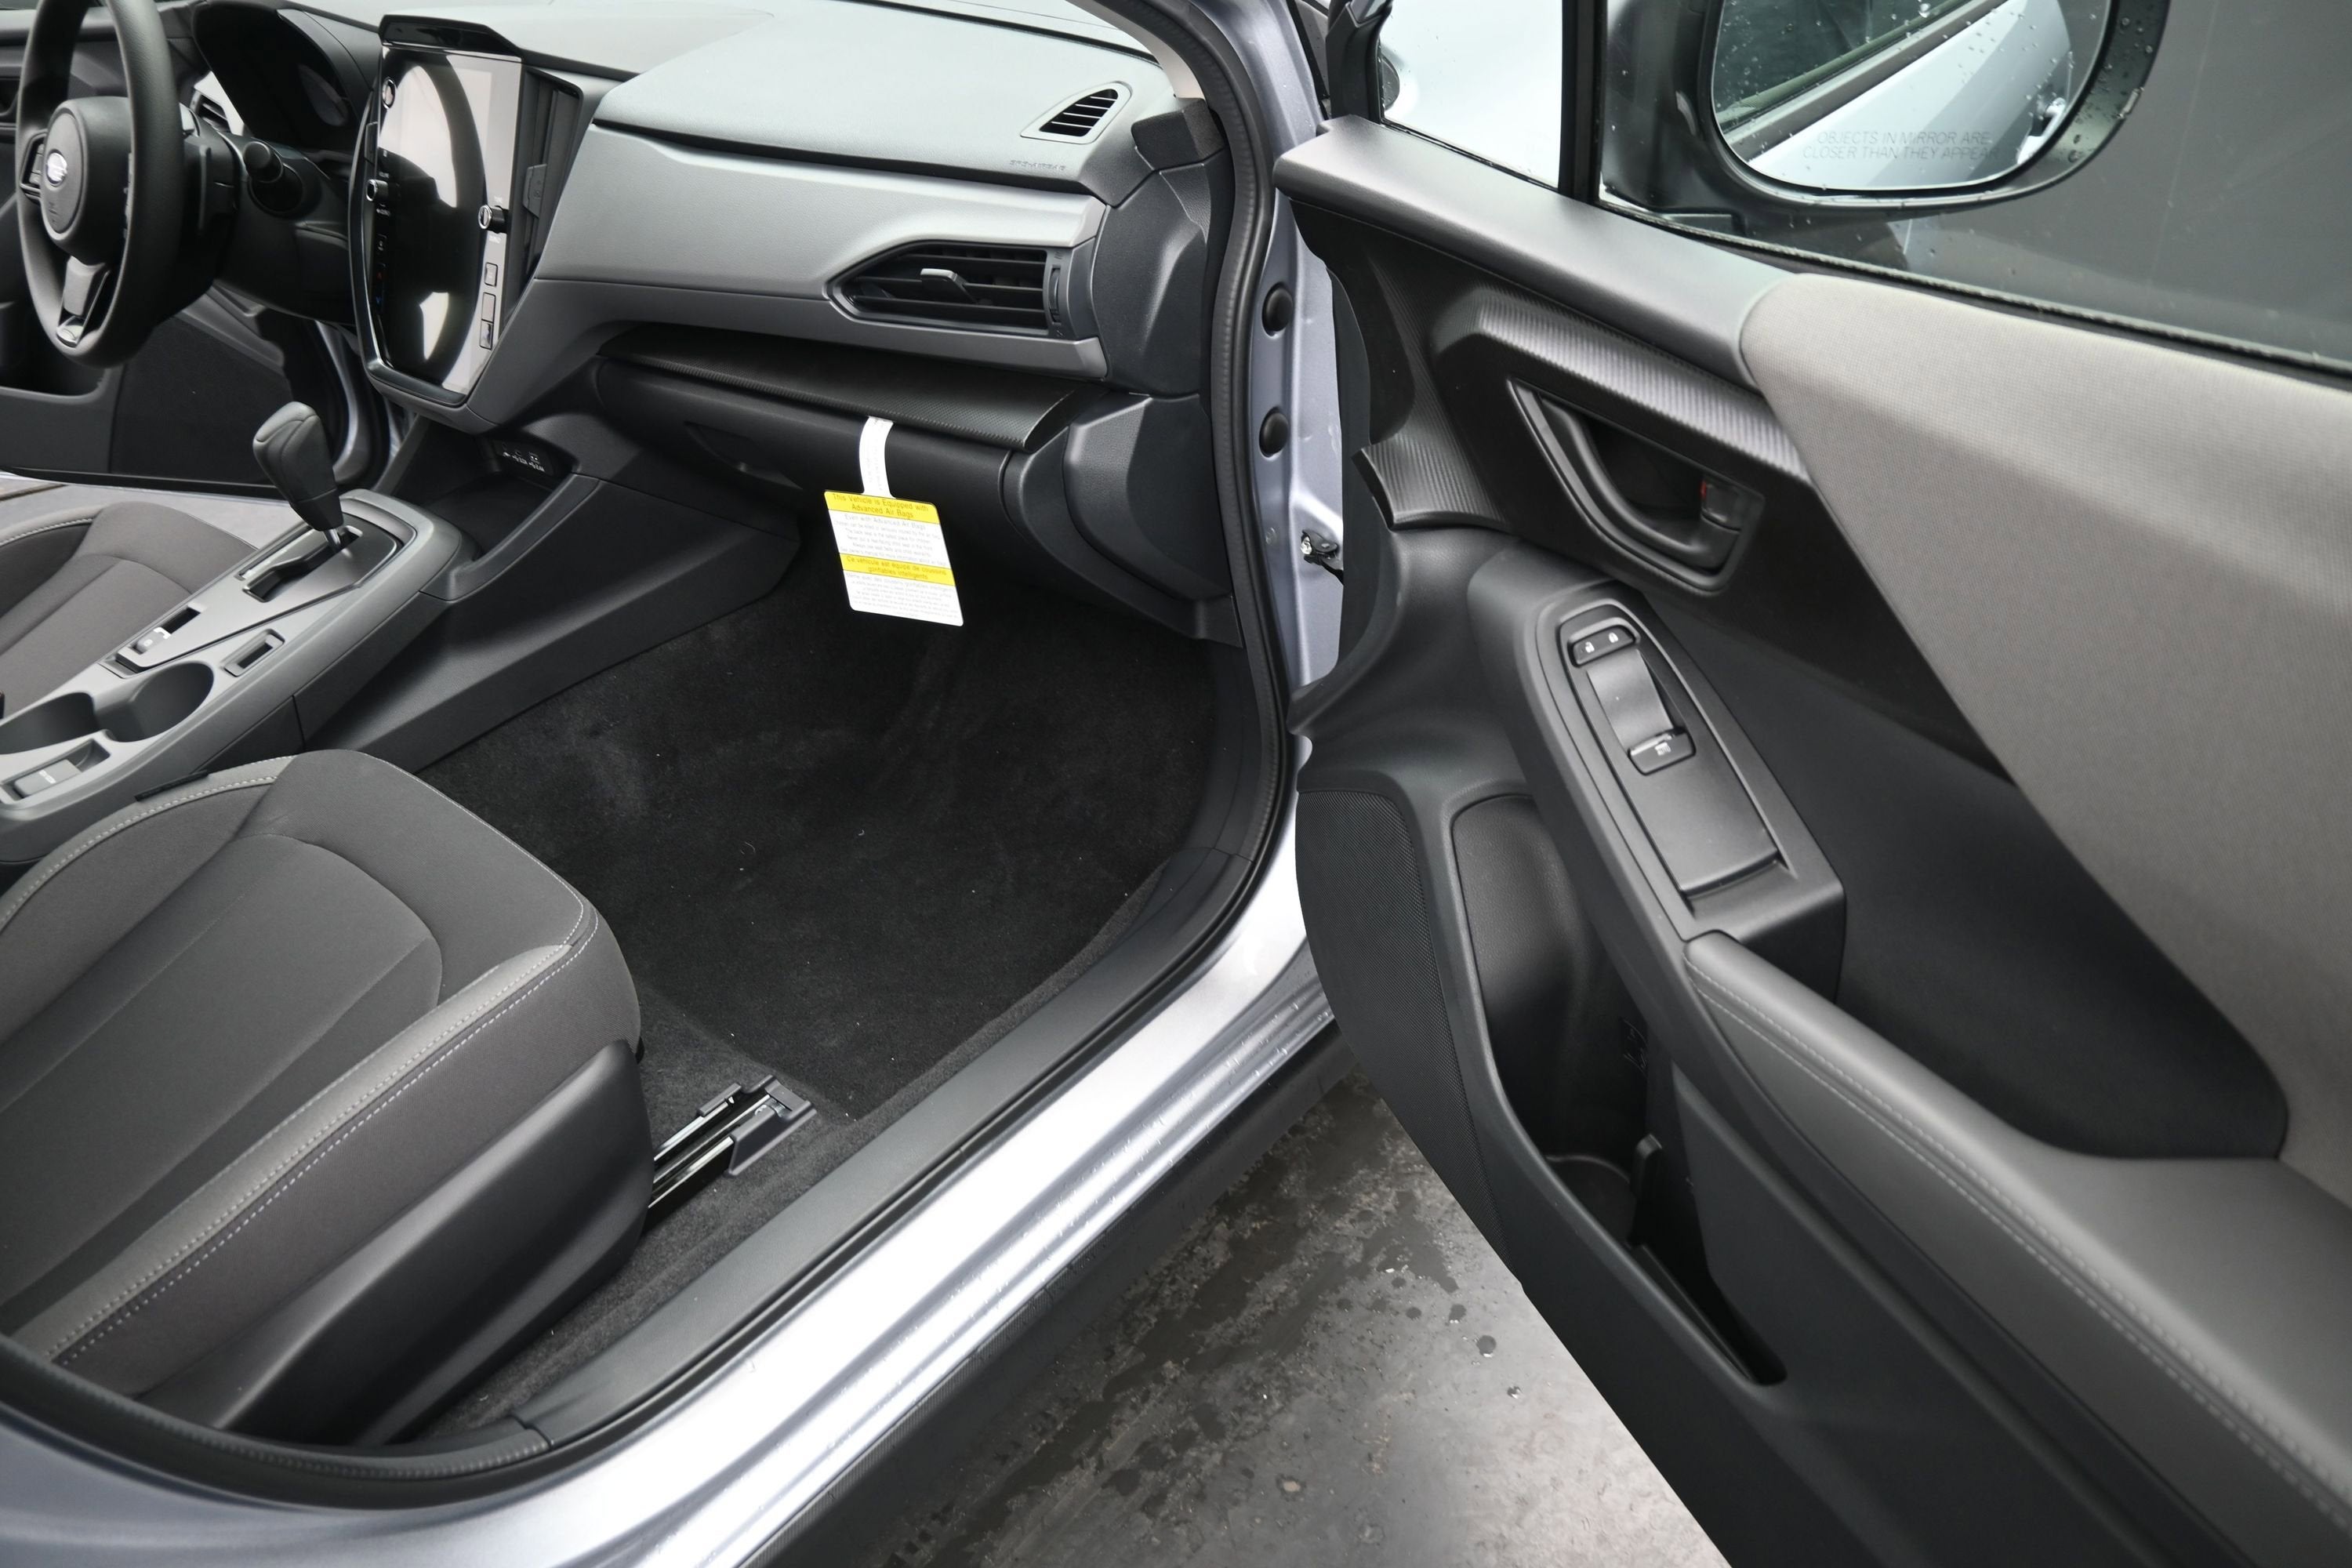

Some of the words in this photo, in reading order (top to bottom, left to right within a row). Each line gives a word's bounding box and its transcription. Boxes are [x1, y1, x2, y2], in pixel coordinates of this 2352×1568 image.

[1817, 131, 1878, 145] OBJECTS
[1883, 131, 1896, 145] IN
[1900, 131, 1958, 145] MIRROR
[1962, 131, 1991, 145] ARE
[1802, 146, 1857, 159] CLOSER
[1862, 146, 1900, 159] THAN
[1903, 146, 1938, 159] THEY
[1942, 146, 1998, 159] APPEAR
[848, 494, 873, 504] Vehicle
[882, 499, 913, 510] Equipped
[915, 503, 930, 512] with
[851, 503, 884, 514] Advanced
[896, 509, 914, 521] Bags
